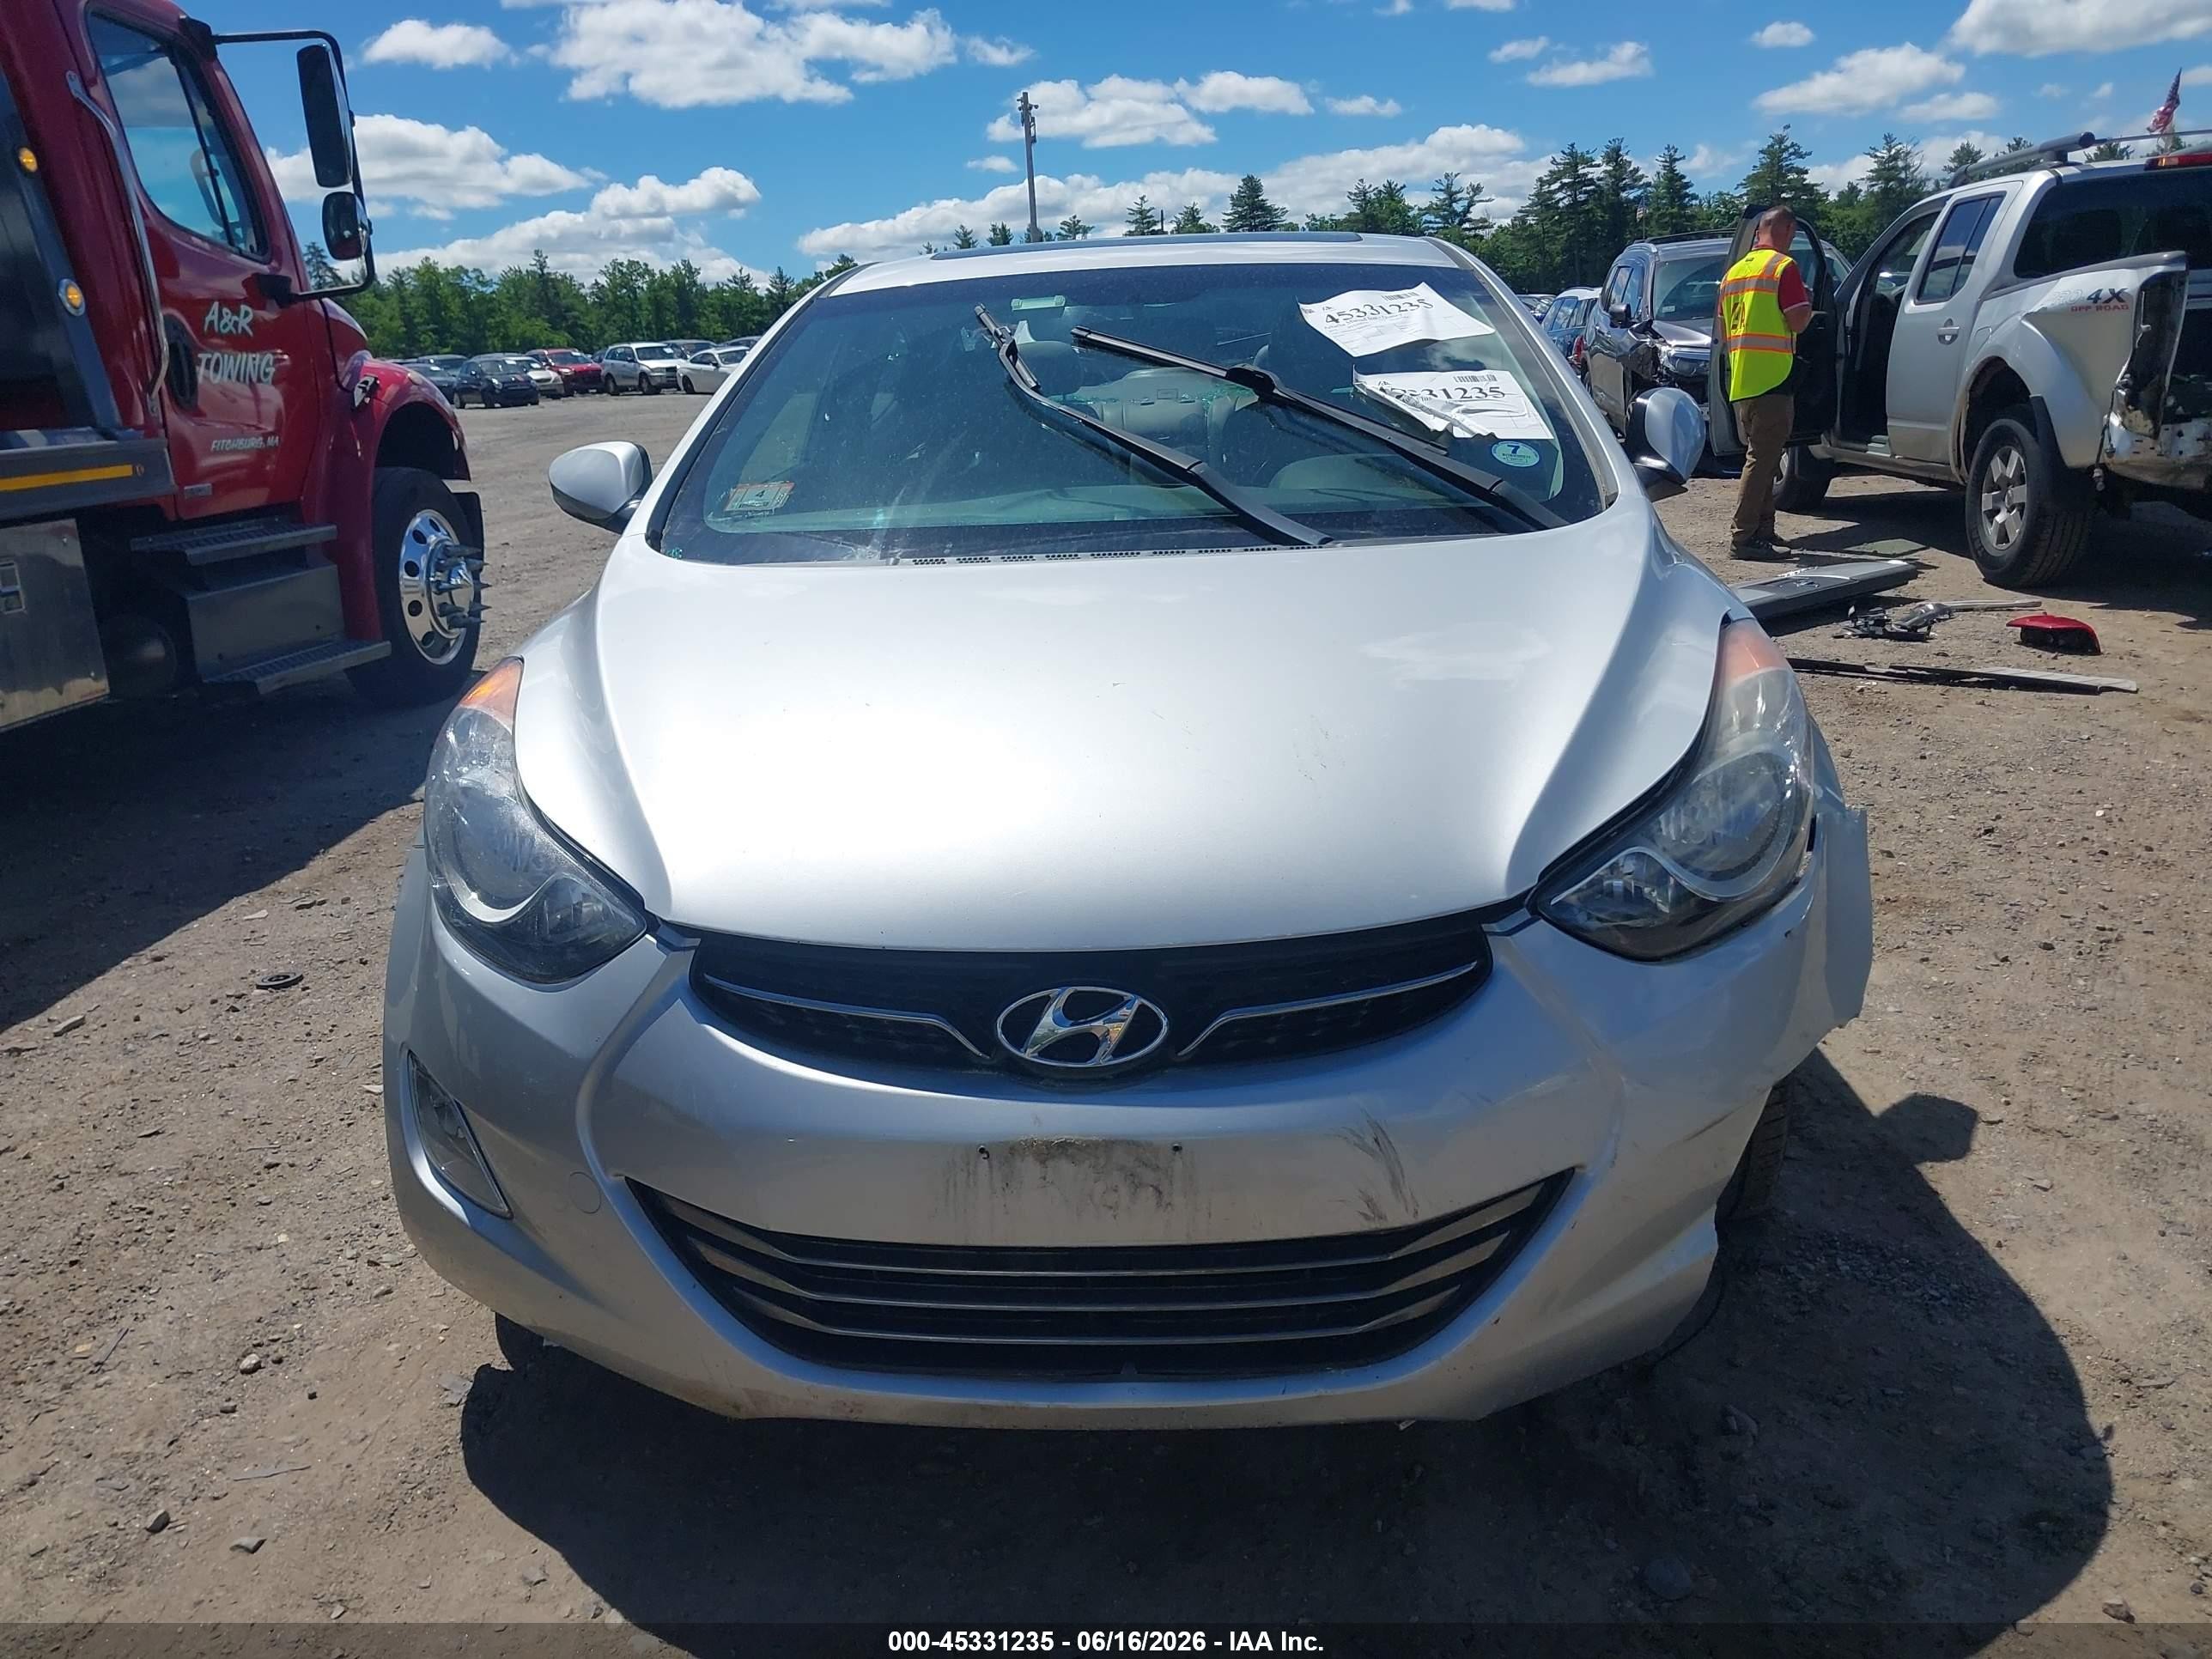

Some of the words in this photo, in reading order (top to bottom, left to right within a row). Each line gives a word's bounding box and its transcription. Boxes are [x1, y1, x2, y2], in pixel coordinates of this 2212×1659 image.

[204, 301, 253, 337] A&R
[1325, 299, 1434, 324] 45331235
[198, 353, 275, 386] TOWING
[1507, 444, 1520, 454] 7
